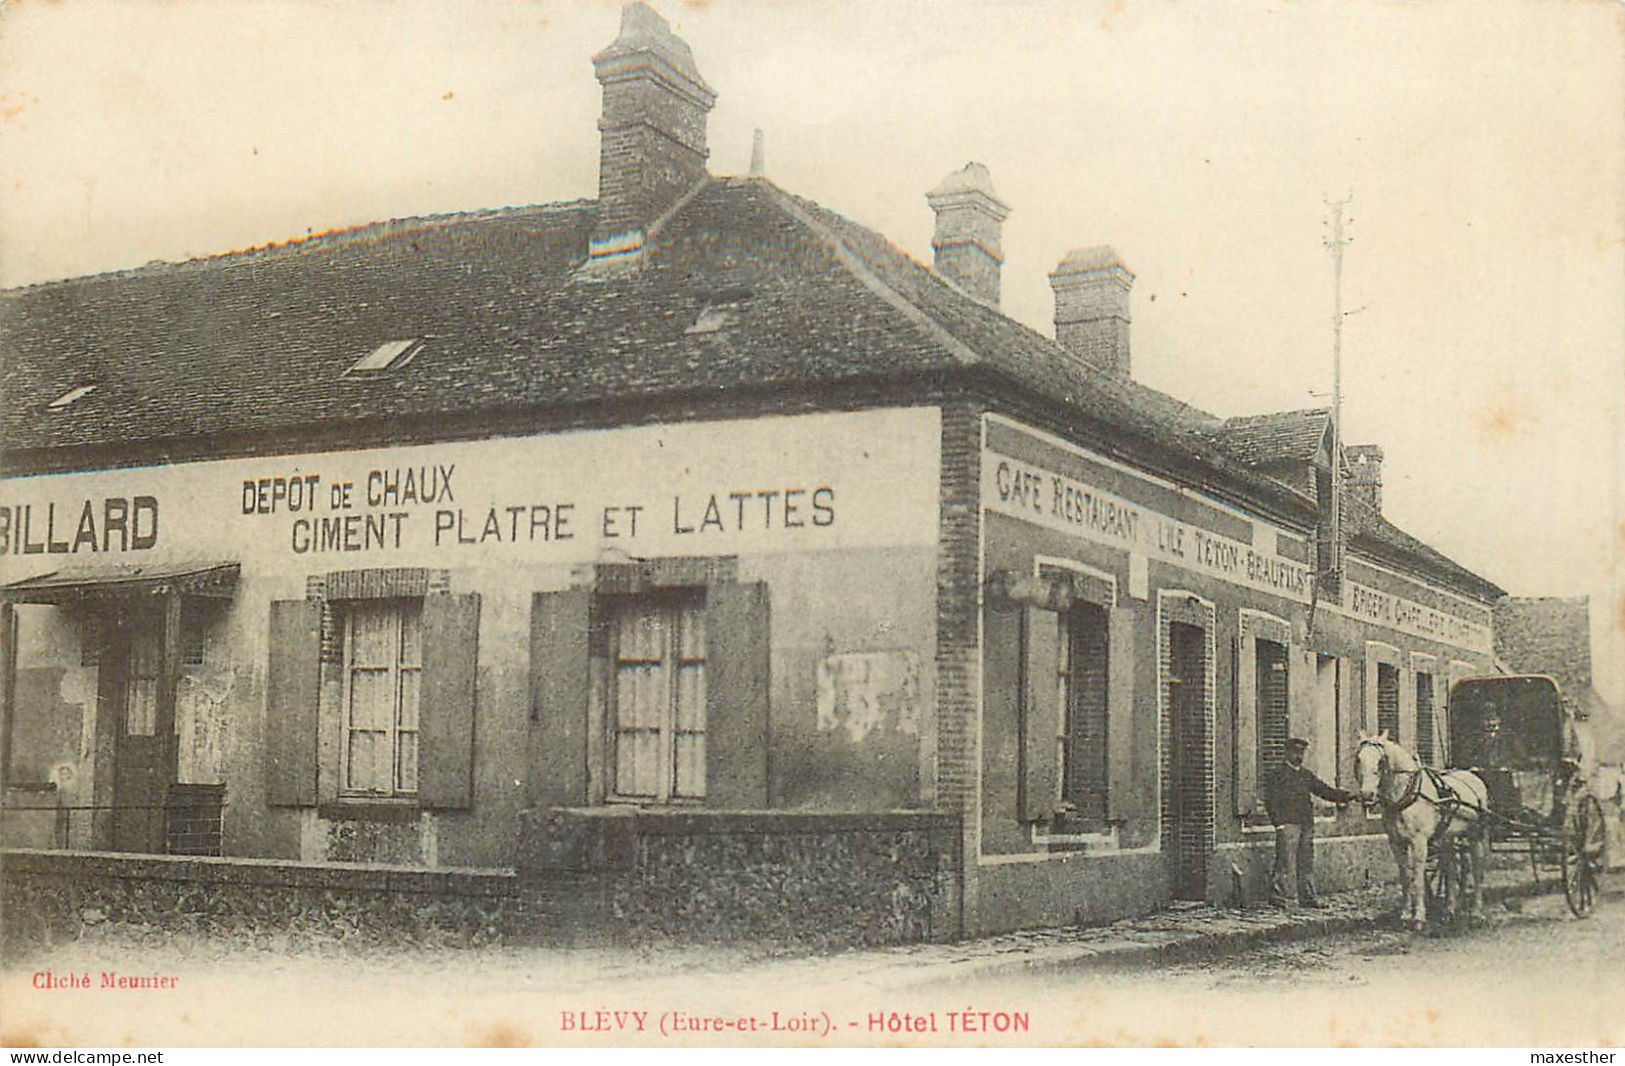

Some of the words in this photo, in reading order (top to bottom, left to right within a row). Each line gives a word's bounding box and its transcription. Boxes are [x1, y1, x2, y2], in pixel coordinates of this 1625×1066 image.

[330, 482, 353, 510] DE
[367, 464, 455, 507] CHAUX
[1051, 467, 1139, 542] RESTAURANT
[0, 496, 159, 555] BILLARD
[292, 512, 409, 554] CIMENT
[602, 506, 643, 538] ET
[674, 488, 834, 534] LATTES
